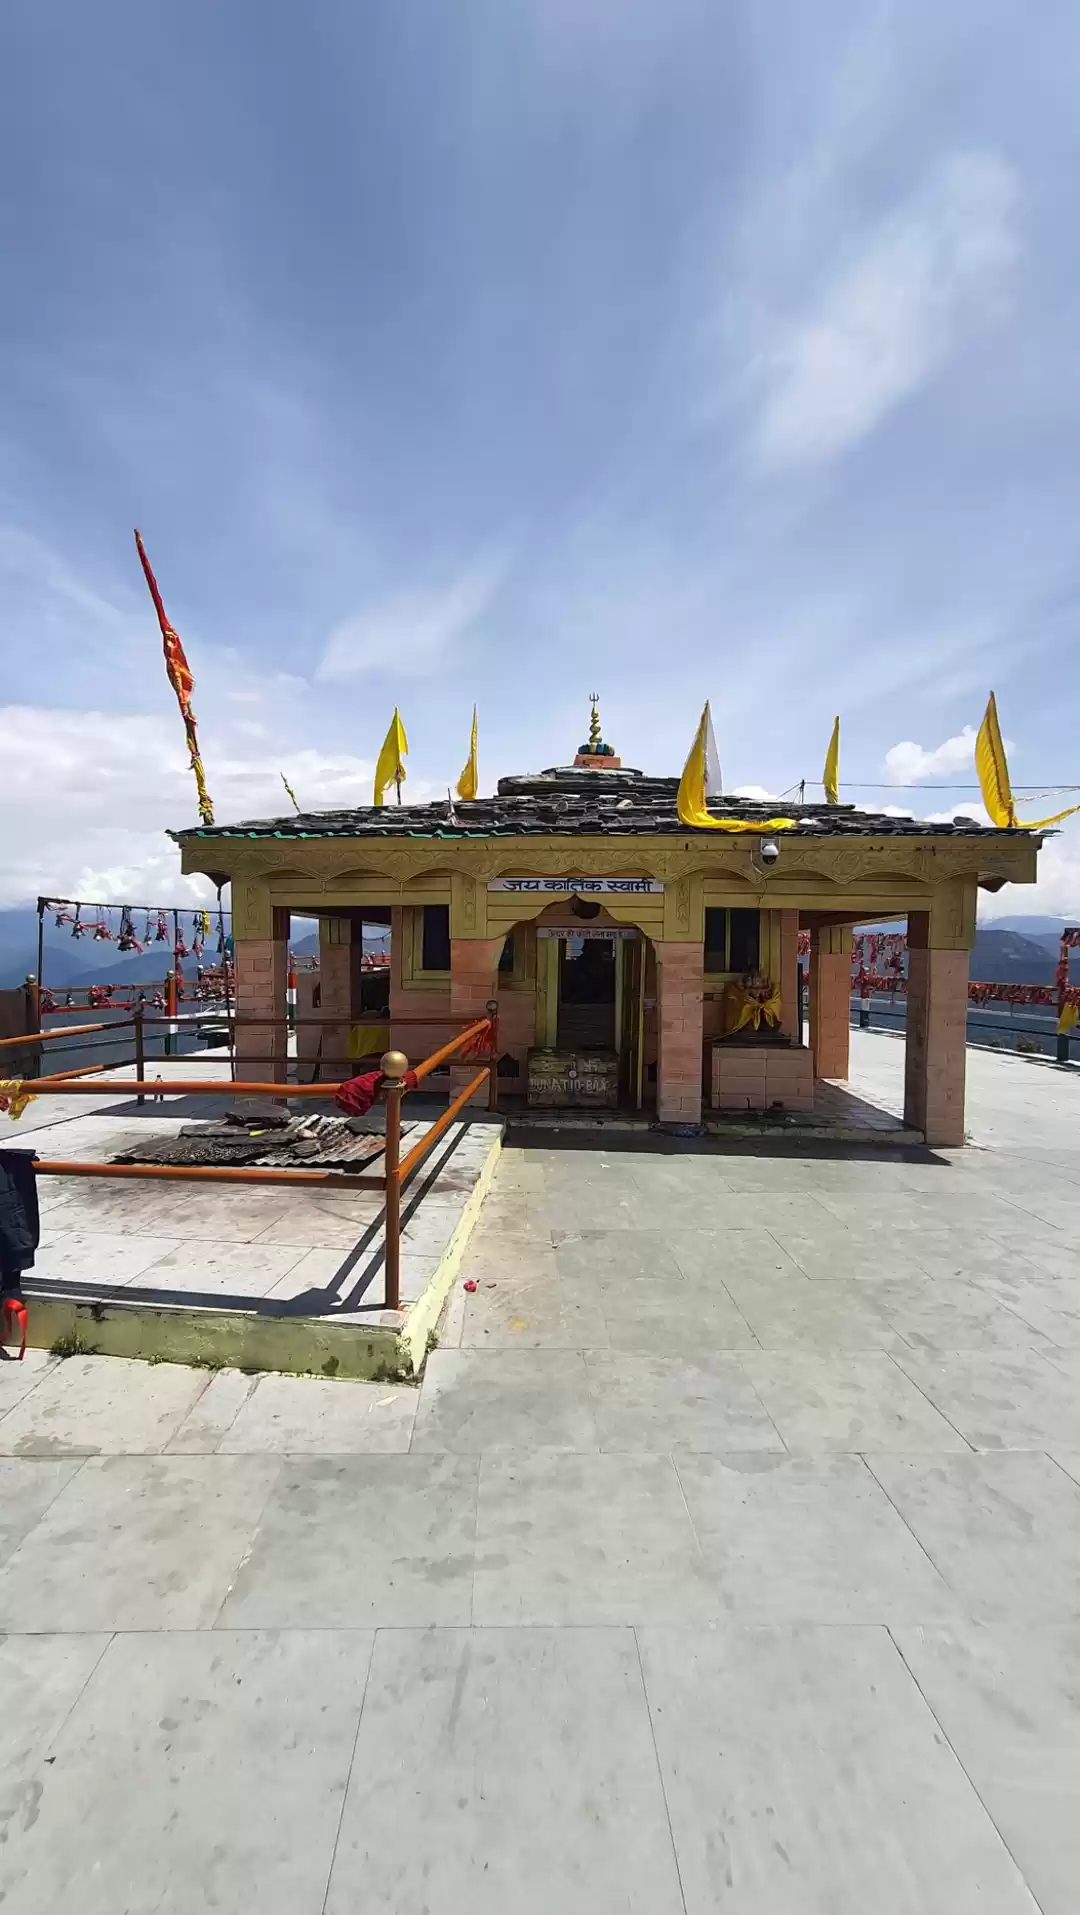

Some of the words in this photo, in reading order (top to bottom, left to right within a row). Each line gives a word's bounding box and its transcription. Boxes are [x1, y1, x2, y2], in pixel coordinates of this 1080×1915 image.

[503, 879, 541, 891] जय
[543, 877, 602, 891] कार्तिक
[606, 878, 653, 892] स्वामी
